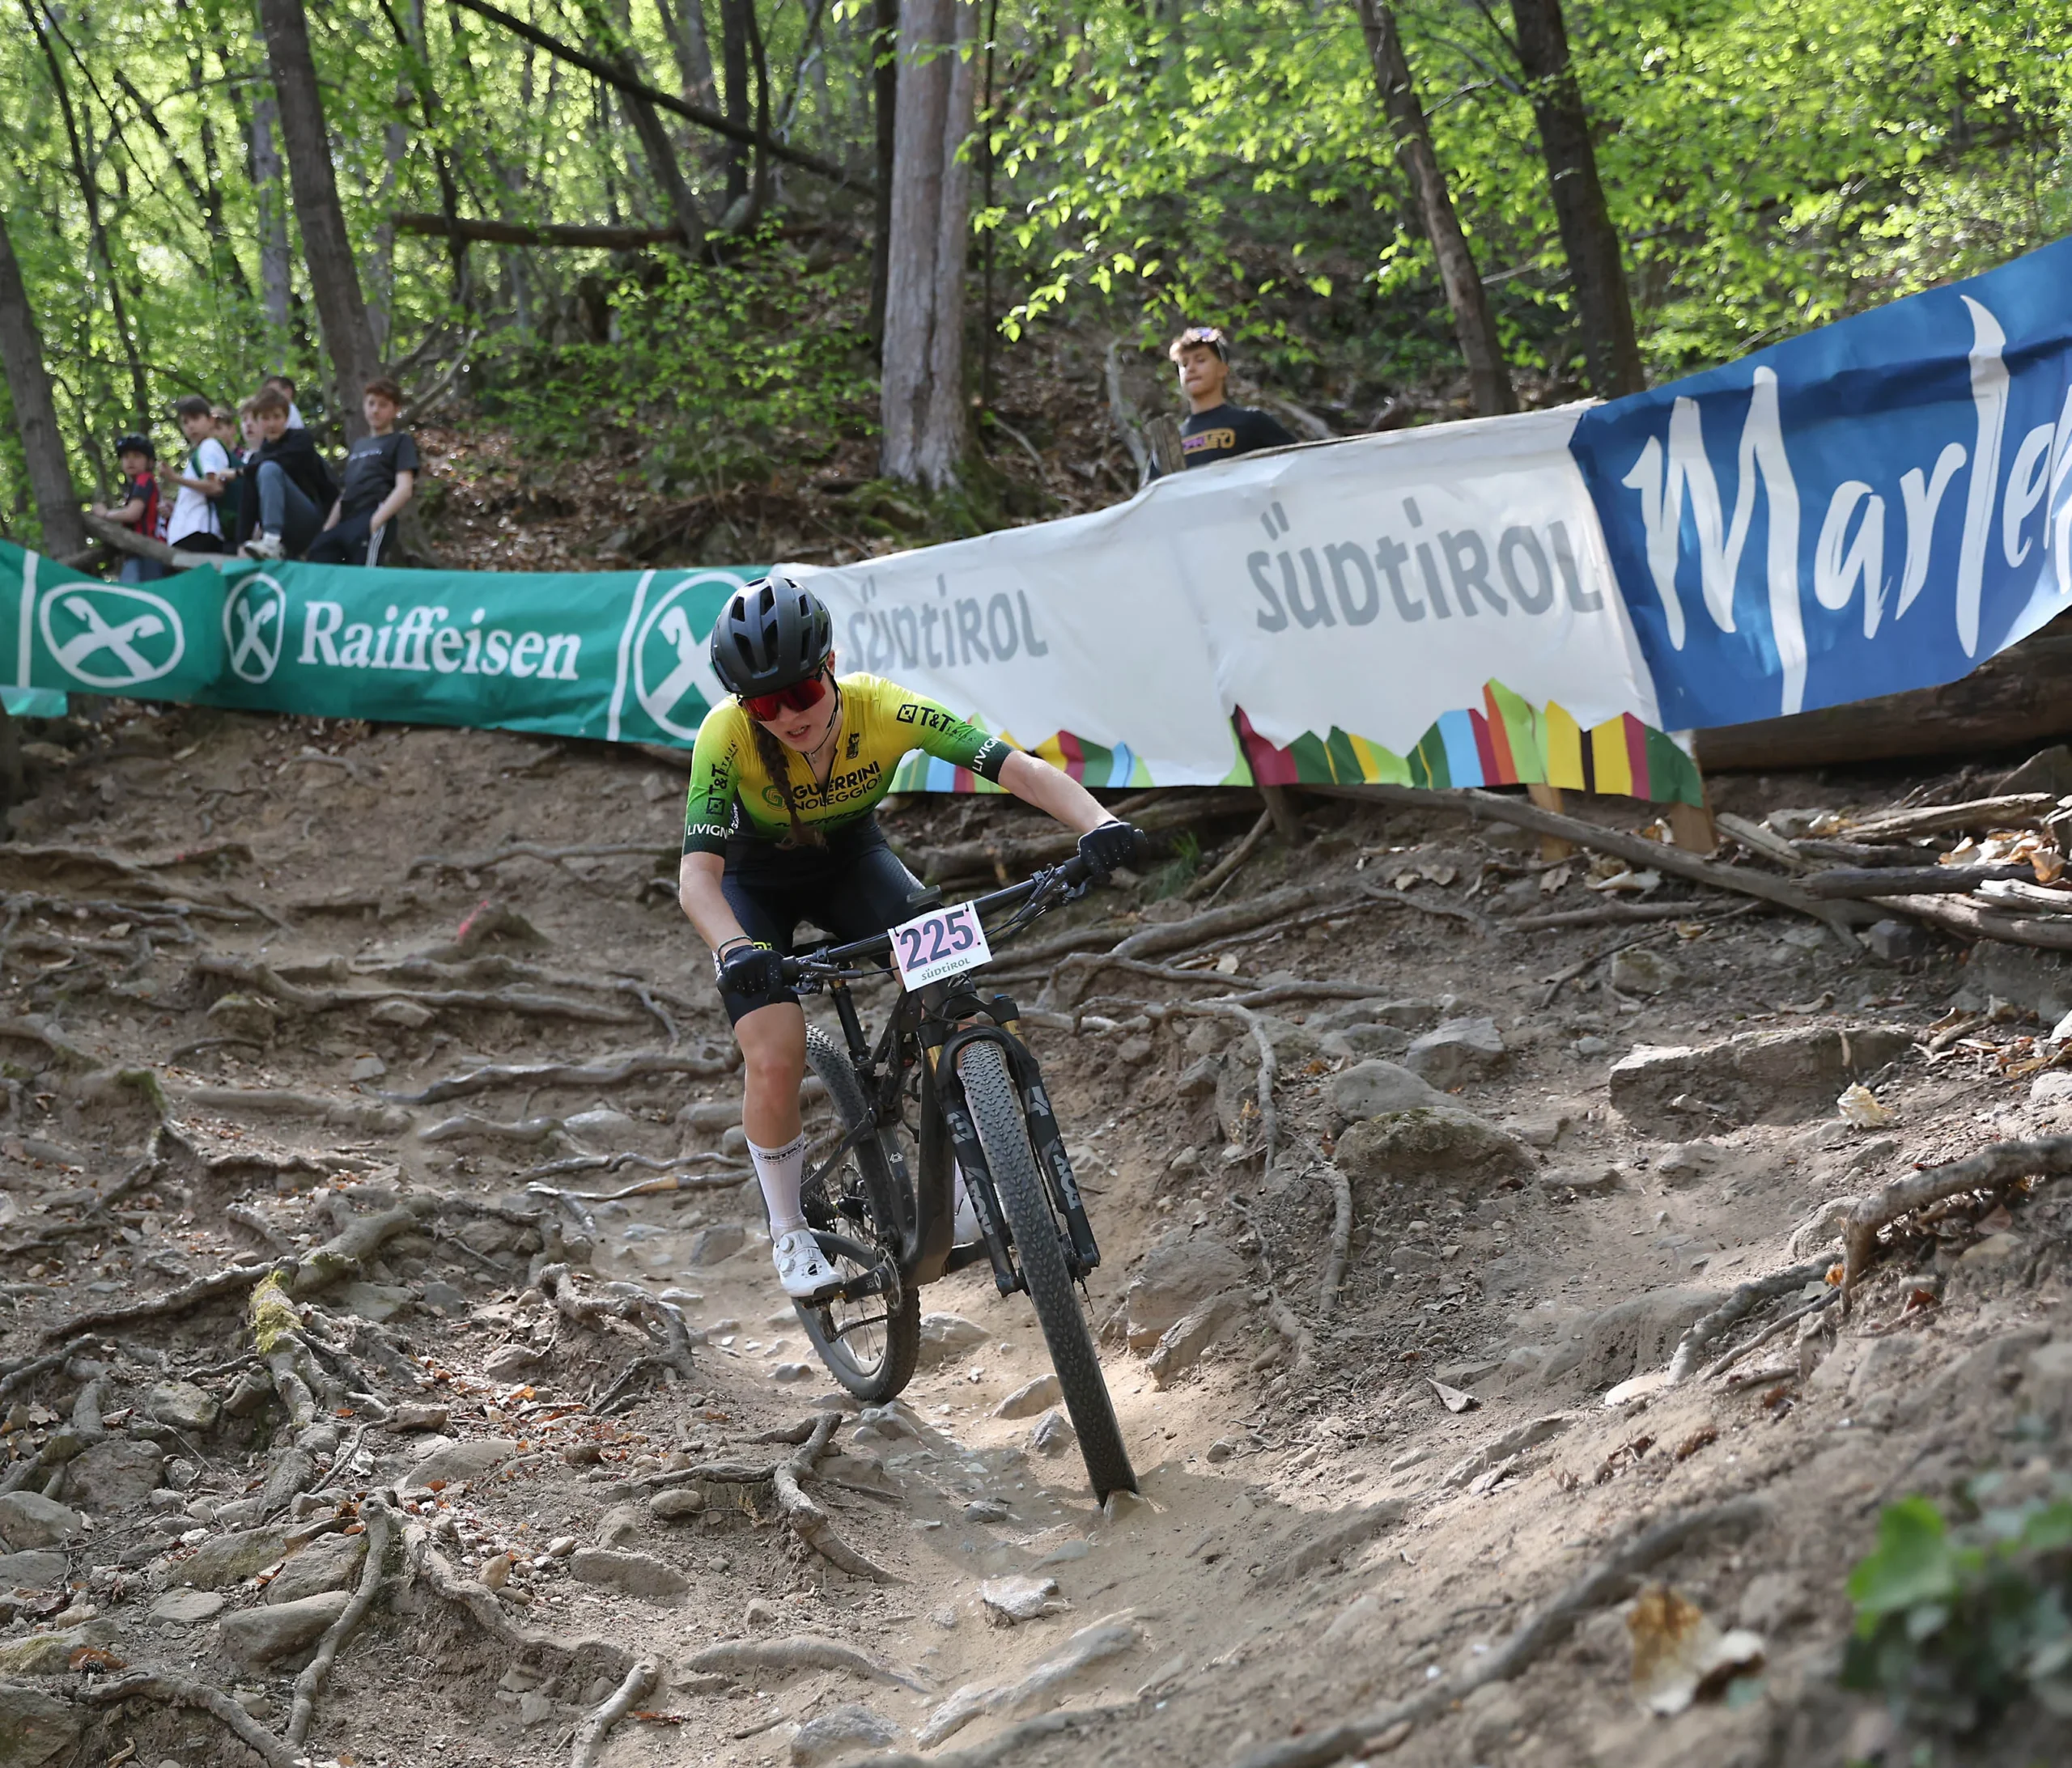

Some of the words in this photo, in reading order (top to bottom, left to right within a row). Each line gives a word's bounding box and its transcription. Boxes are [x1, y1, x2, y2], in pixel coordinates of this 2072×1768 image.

[297, 600, 582, 680] Raiffeisen
[920, 706, 956, 732] T&T
[708, 763, 728, 795] T&T
[793, 761, 881, 799] GUERRINI
[900, 910, 974, 970] 225
